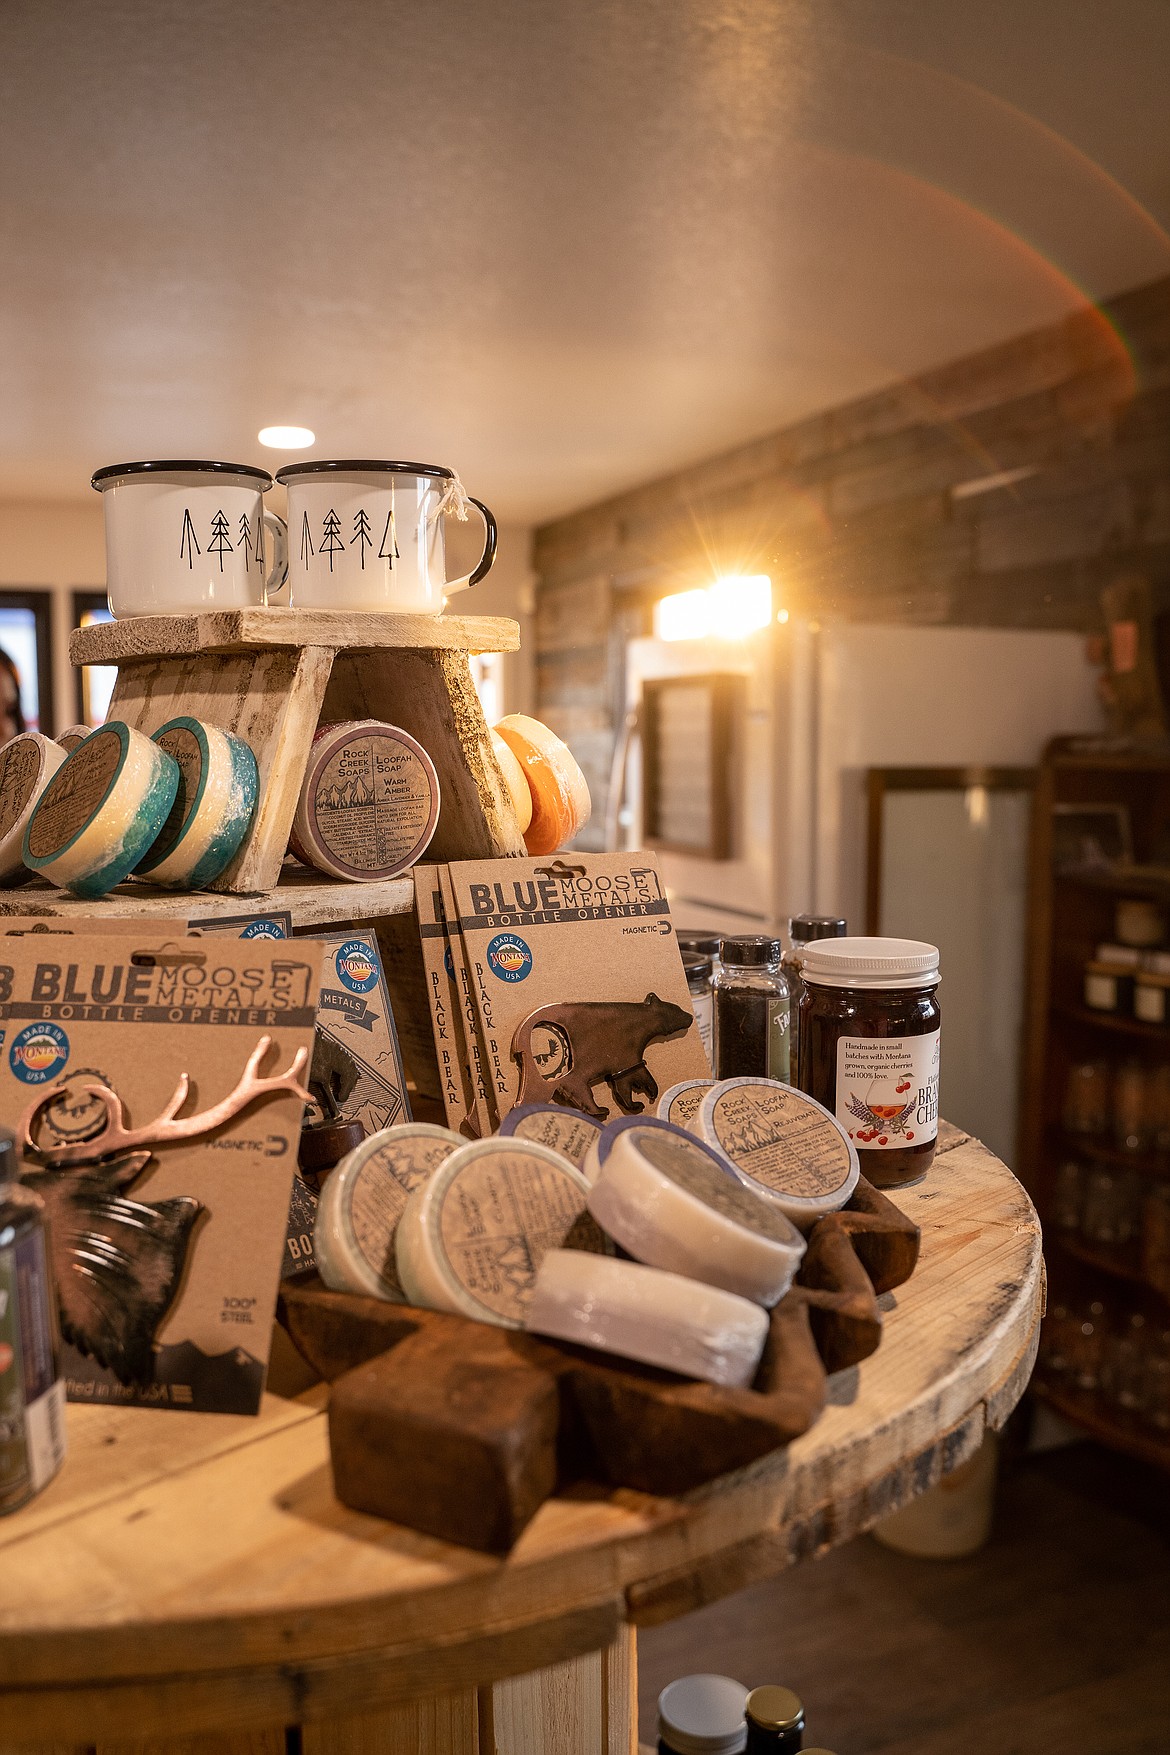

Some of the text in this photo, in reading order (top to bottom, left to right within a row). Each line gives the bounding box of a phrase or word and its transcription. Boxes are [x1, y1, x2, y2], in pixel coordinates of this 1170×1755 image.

[159, 737, 175, 747] ROCK
[175, 749, 199, 760] LOOFAH
[343, 750, 369, 759] ROCK
[376, 755, 412, 765] LOOFAH
[339, 759, 369, 768] CREEK
[377, 765, 402, 773] SOAP
[338, 768, 370, 778] SOAPS
[383, 778, 407, 787] WARM
[384, 787, 411, 796] AMBER
[560, 874, 649, 893] MOOSE
[469, 879, 561, 915] BLUE
[562, 888, 651, 909] METALS
[487, 904, 648, 928] BOTTLE OPENER
[247, 923, 281, 938] MADE IN
[622, 925, 658, 935] MAGNETIC
[493, 936, 525, 948] MADE IN
[343, 943, 374, 958] MADE IN
[490, 951, 531, 967] MONTANA
[339, 958, 378, 976] MONTANA
[159, 965, 293, 989] MOOSE
[505, 972, 521, 980] USA
[31, 963, 155, 1004] BLUE
[351, 982, 367, 991] USA
[155, 986, 290, 1010] METALS
[323, 994, 362, 1011] METALS
[42, 1005, 277, 1025] BOTTLE OPENER
[22, 1025, 64, 1042] MADE IN
[460, 967, 490, 1100] BLACK BEAR
[475, 962, 509, 1093] BLACK BEAR
[431, 971, 460, 1104] BLACK BEAR
[845, 1042, 879, 1051] Handmade
[886, 1043, 903, 1051] small
[14, 1045, 67, 1066] MONTANA
[845, 1052, 869, 1060] batches
[869, 1052, 885, 1060] with
[866, 1063, 890, 1072] organic
[890, 1062, 914, 1070] cherries
[26, 1071, 47, 1082] USA
[755, 1093, 789, 1108] LOOFAH
[917, 1080, 939, 1107] BRA
[677, 1097, 702, 1108] ROCK
[679, 1105, 699, 1114] CRE
[721, 1098, 746, 1110] ROCK
[761, 1103, 785, 1115] SOAP
[723, 1105, 752, 1117] CREEK
[727, 1112, 758, 1126] SOAPS
[773, 1109, 819, 1129] REJUVENATE
[538, 1115, 556, 1143] LOOFAH
